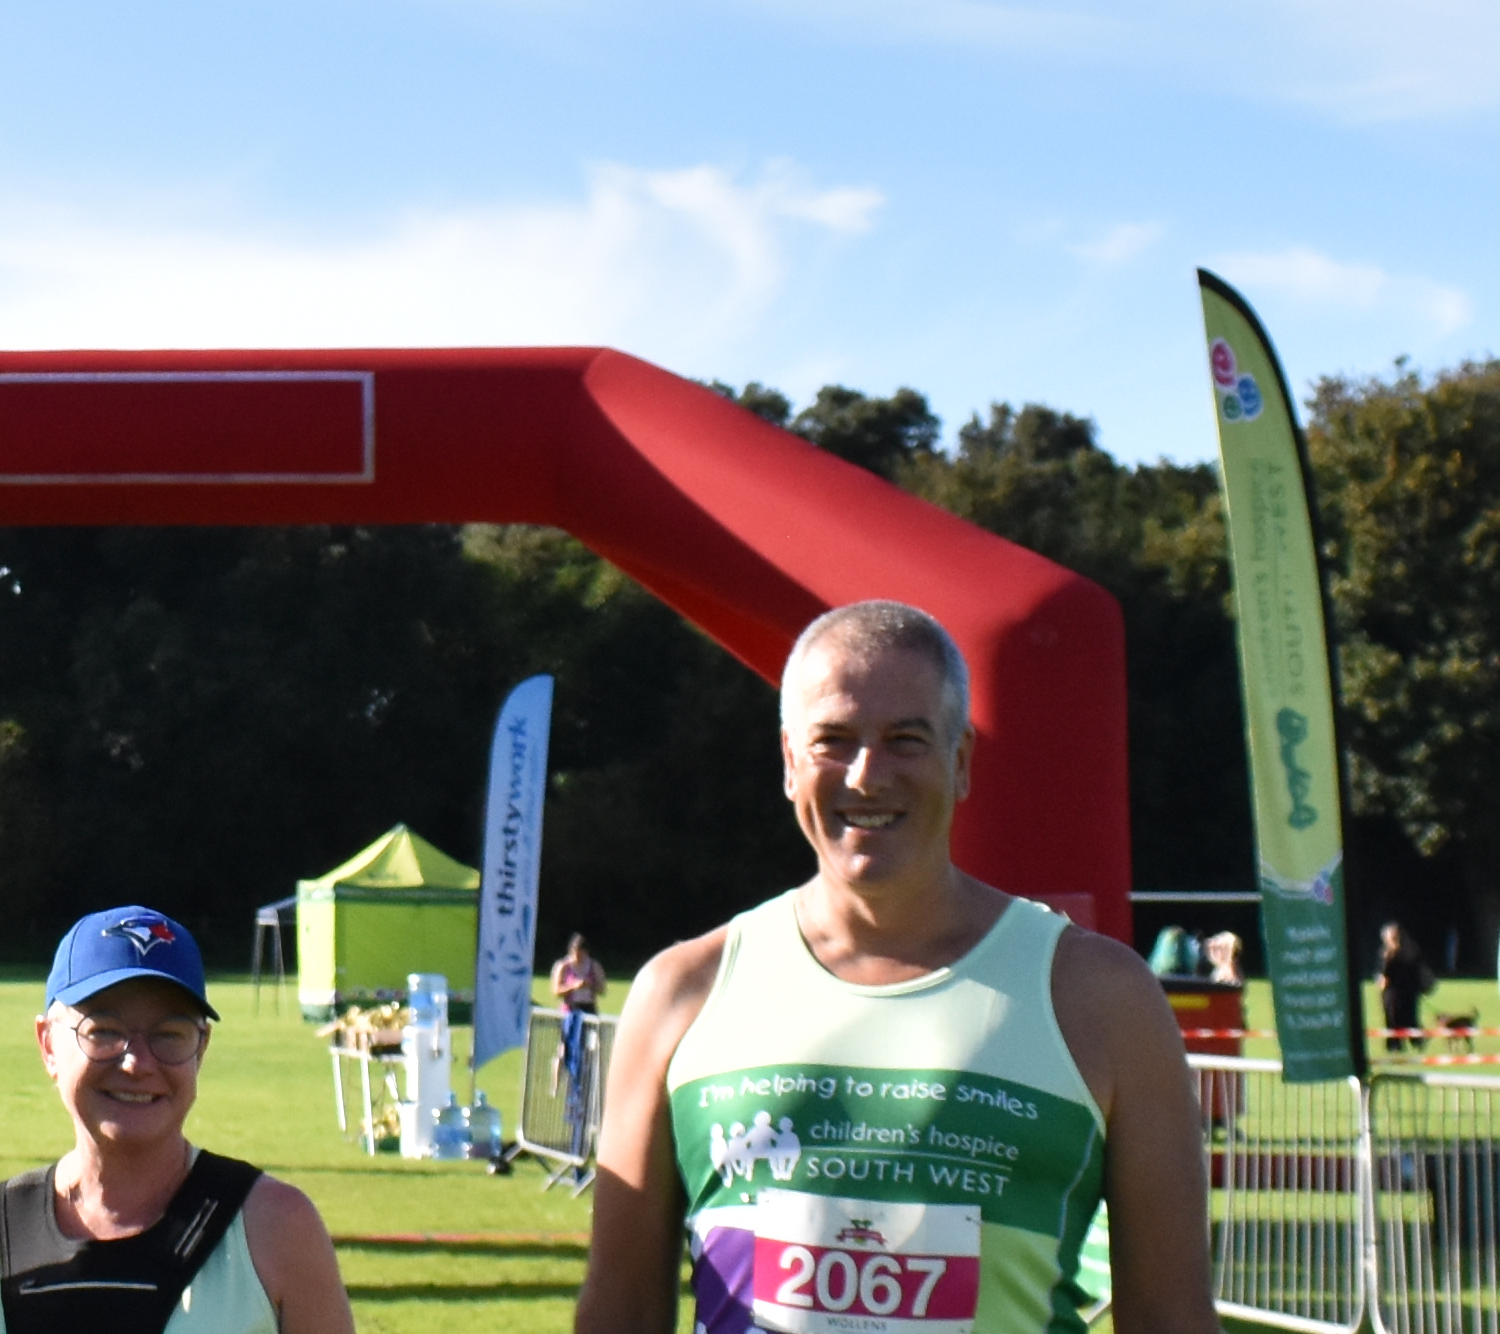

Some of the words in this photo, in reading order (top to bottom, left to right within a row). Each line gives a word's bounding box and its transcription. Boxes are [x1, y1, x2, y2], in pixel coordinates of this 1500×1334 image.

[496, 715, 528, 917] thirstywork
[698, 1083, 734, 1107] I'm
[740, 1074, 836, 1099] helping
[845, 1075, 873, 1097] to
[880, 1078, 946, 1101] raise
[955, 1084, 1039, 1120] smiles
[809, 1119, 920, 1144] children's
[930, 1124, 1019, 1161] hospice
[807, 1156, 915, 1183] SOUTH
[929, 1163, 1011, 1196] WEST
[776, 1245, 947, 1318] 2067
[827, 1317, 887, 1331] WOLLENS
